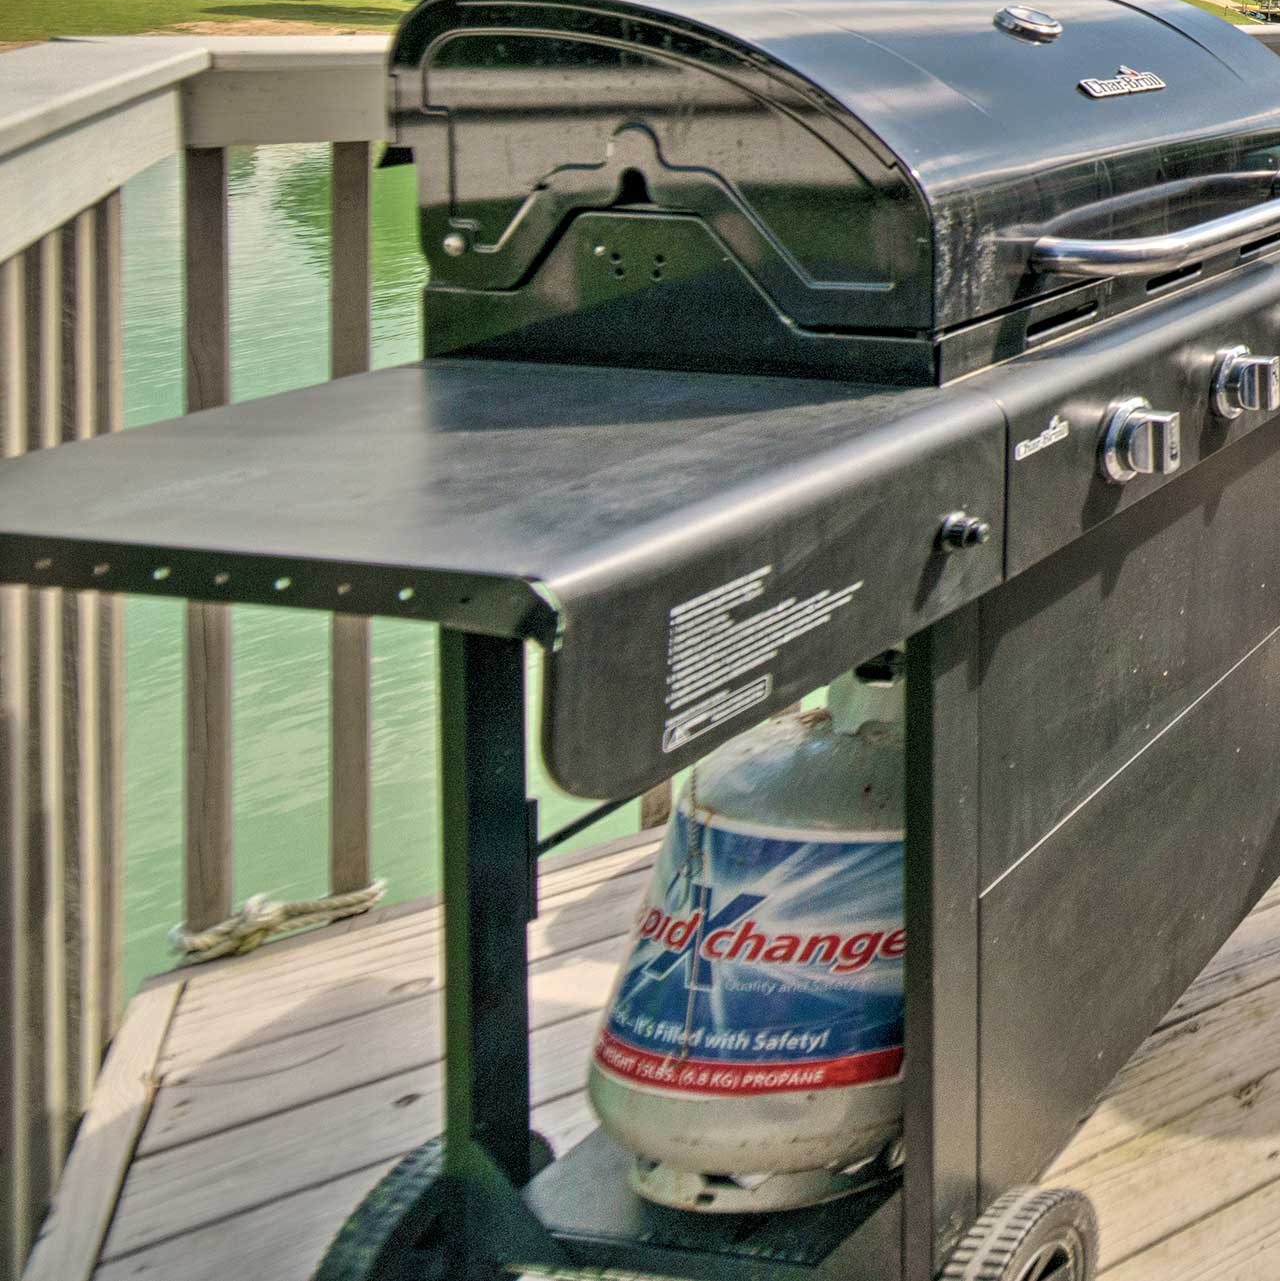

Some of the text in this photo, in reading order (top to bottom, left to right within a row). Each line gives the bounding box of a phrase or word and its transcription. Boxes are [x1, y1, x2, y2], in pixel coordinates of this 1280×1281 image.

[1082, 72, 1164, 96] Char-Broil
[653, 1021, 706, 1047] Filled
[704, 1028, 750, 1051] with
[751, 1027, 832, 1054] Safety!
[709, 1069, 740, 1089] KG)
[740, 1069, 825, 1087] PROPANE
